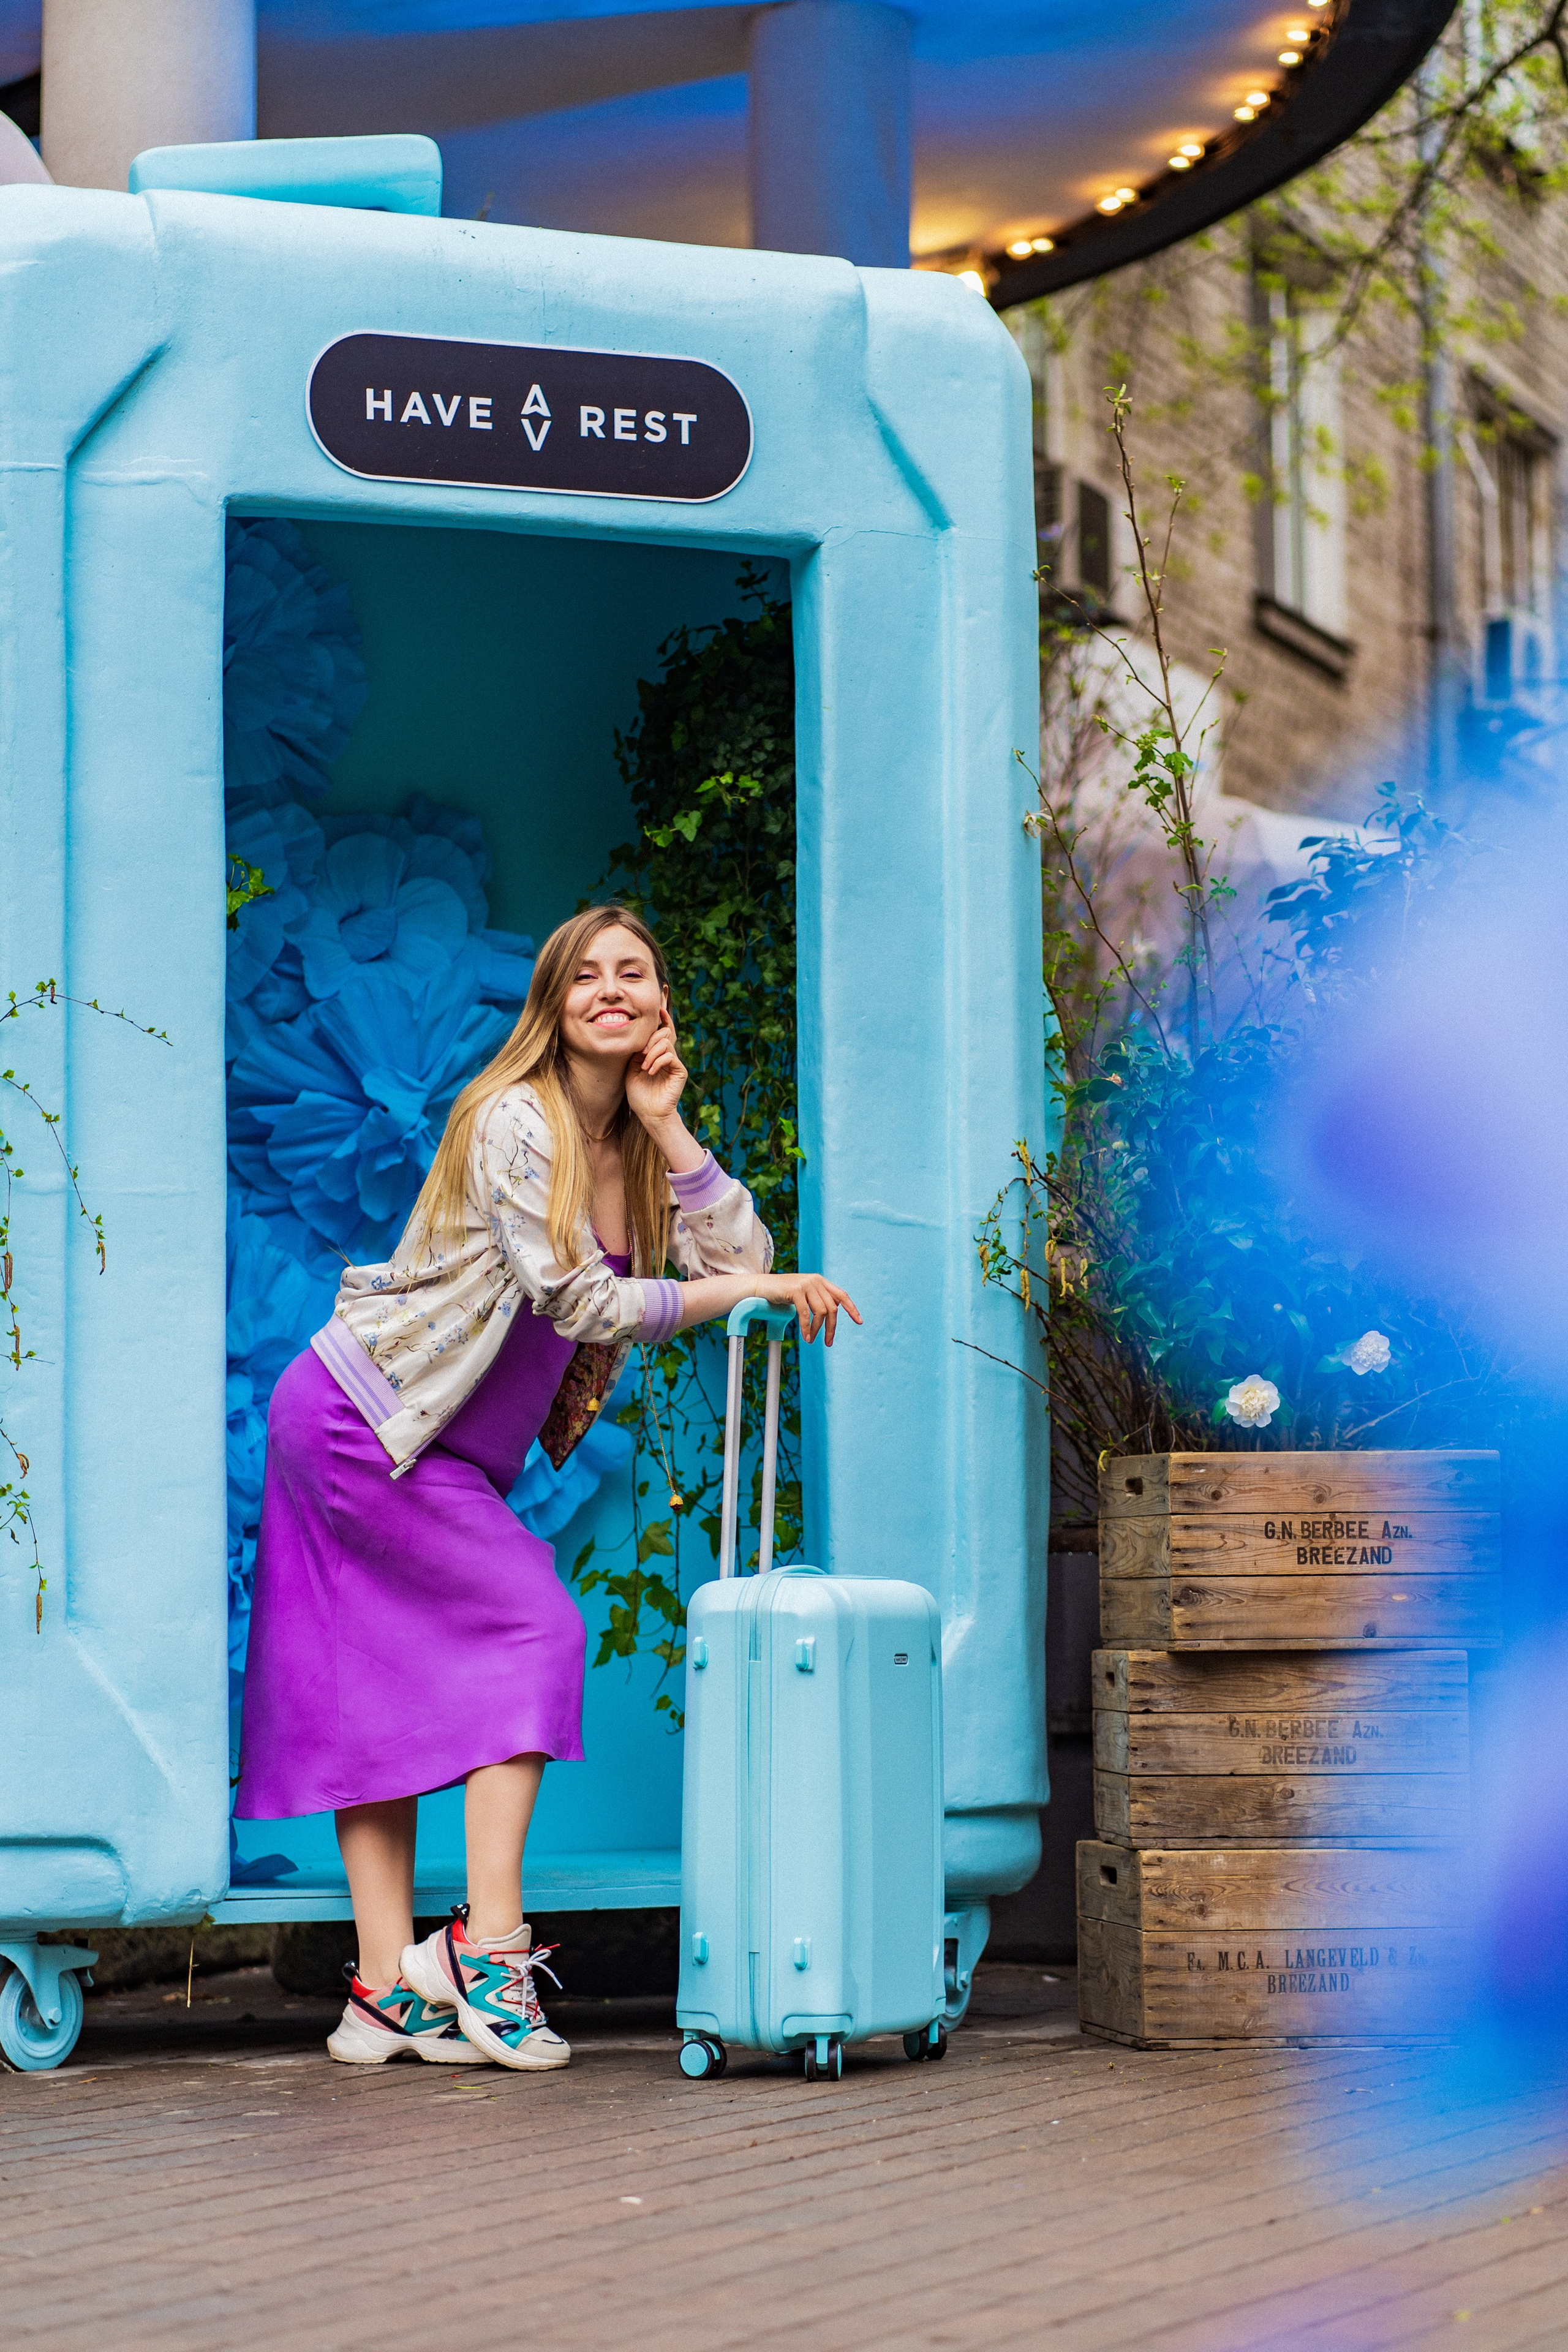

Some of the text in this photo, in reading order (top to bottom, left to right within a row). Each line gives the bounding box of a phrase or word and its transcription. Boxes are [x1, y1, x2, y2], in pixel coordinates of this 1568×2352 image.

[366, 388, 492, 429] HAVE
[580, 405, 697, 445] REST
[1264, 1521, 1297, 1539] G.N.
[1301, 1521, 1369, 1539] BERBEE
[1297, 1546, 1393, 1565] BREEZAND
[1266, 1720, 1339, 1738] BERBEE
[1261, 1746, 1357, 1765] BREEZAND
[1285, 1947, 1379, 1969] LANGEVELD
[1268, 1973, 1349, 1994] BREEZAND
